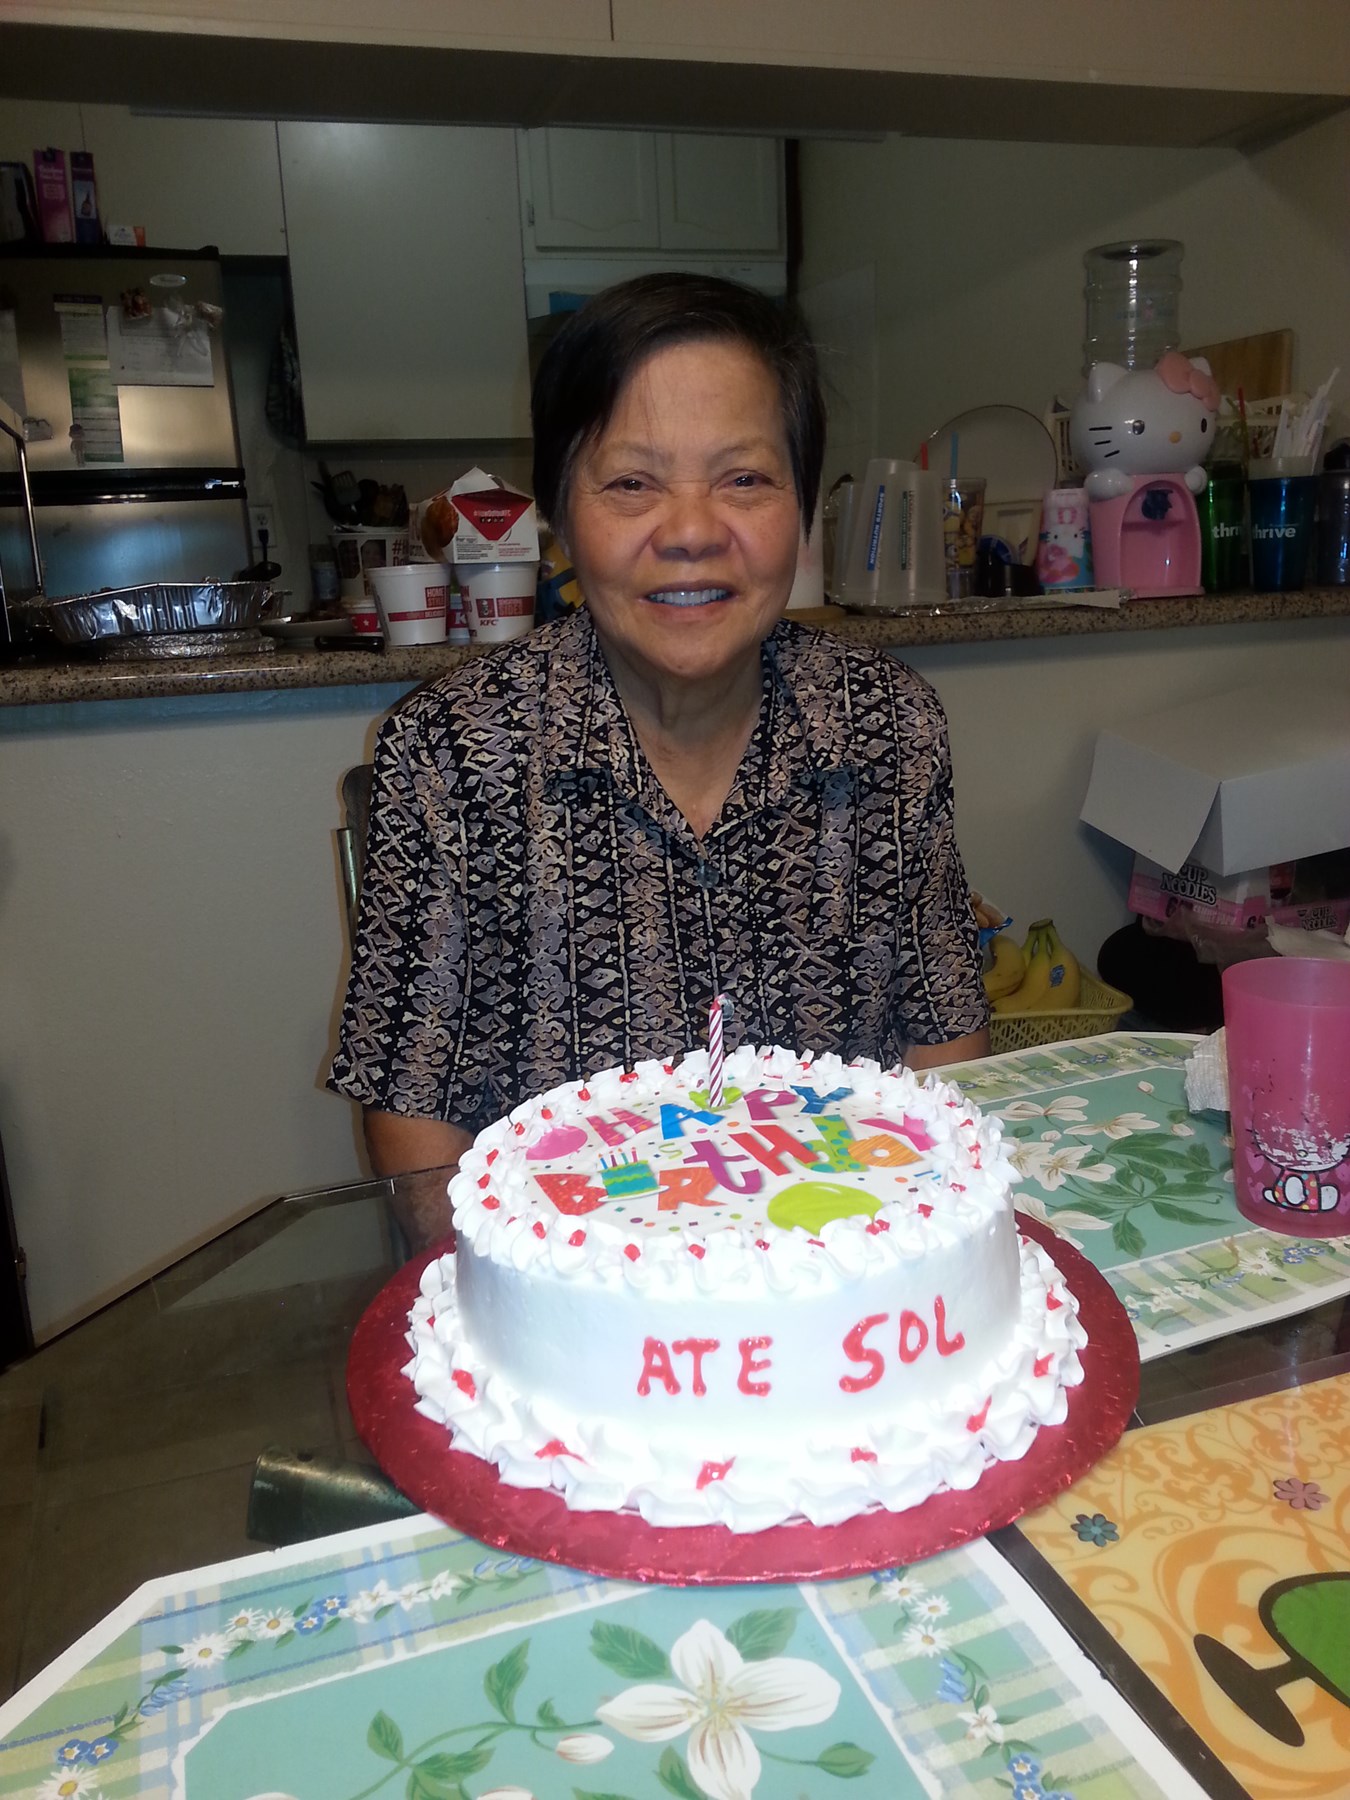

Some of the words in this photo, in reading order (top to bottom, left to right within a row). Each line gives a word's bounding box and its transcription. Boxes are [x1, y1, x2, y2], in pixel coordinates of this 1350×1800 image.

[876, 492, 885, 522] SPORTS
[869, 524, 881, 565] NUTRITION
[1160, 872, 1217, 906] NOODLES
[1180, 864, 1209, 883] CUP
[1311, 905, 1334, 918] CUP
[637, 1335, 774, 1398] ATE
[838, 1294, 966, 1394] SOL
